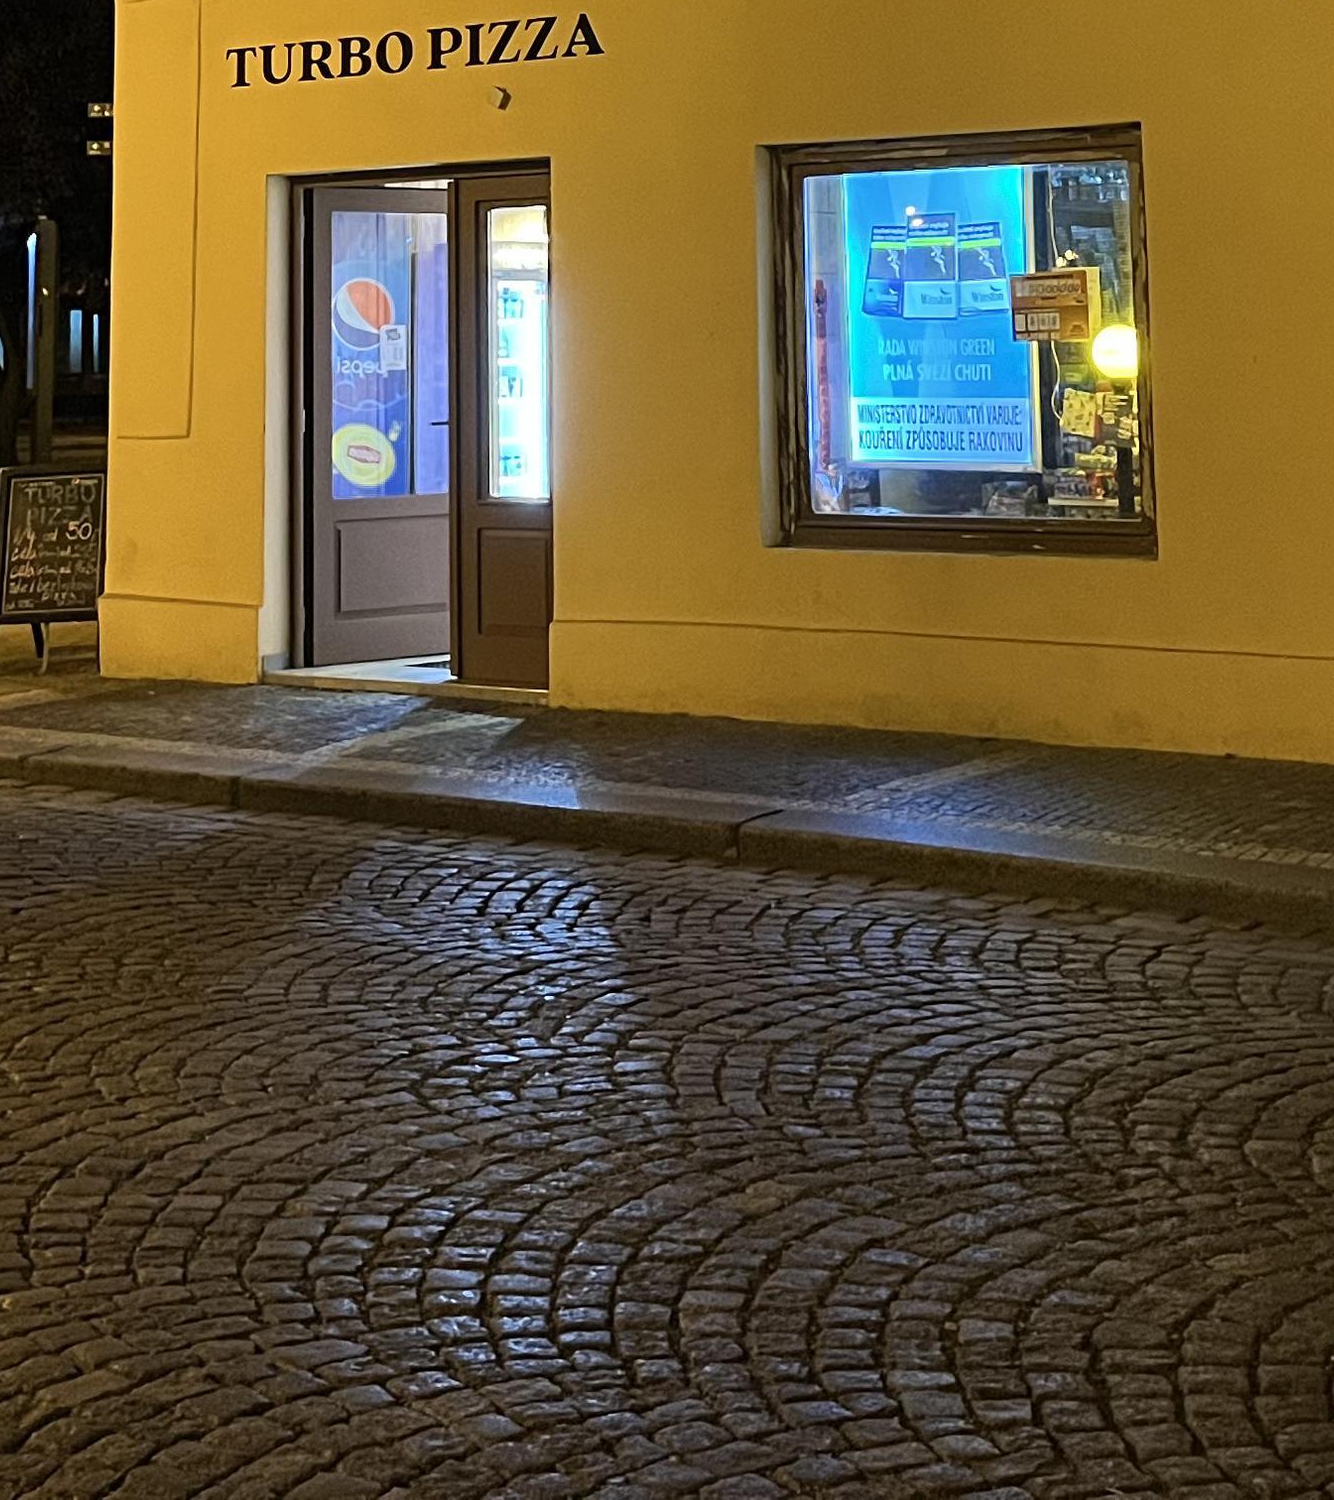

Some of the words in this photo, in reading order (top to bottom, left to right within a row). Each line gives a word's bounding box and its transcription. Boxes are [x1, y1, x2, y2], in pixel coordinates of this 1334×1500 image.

[227, 32, 412, 87] TURBO
[427, 14, 604, 69] PIZZA
[907, 338, 957, 357] WISTON
[961, 338, 995, 356] GREEN
[883, 360, 914, 381] PLNÁ
[954, 363, 991, 381] CHUTI
[857, 404, 917, 424] MINISTERSTVO
[858, 426, 904, 450] KOUŘENÍ
[906, 426, 966, 451] ZPŮSOBUJE
[968, 430, 1023, 453] RAKOVINU
[24, 484, 96, 504] TURBO
